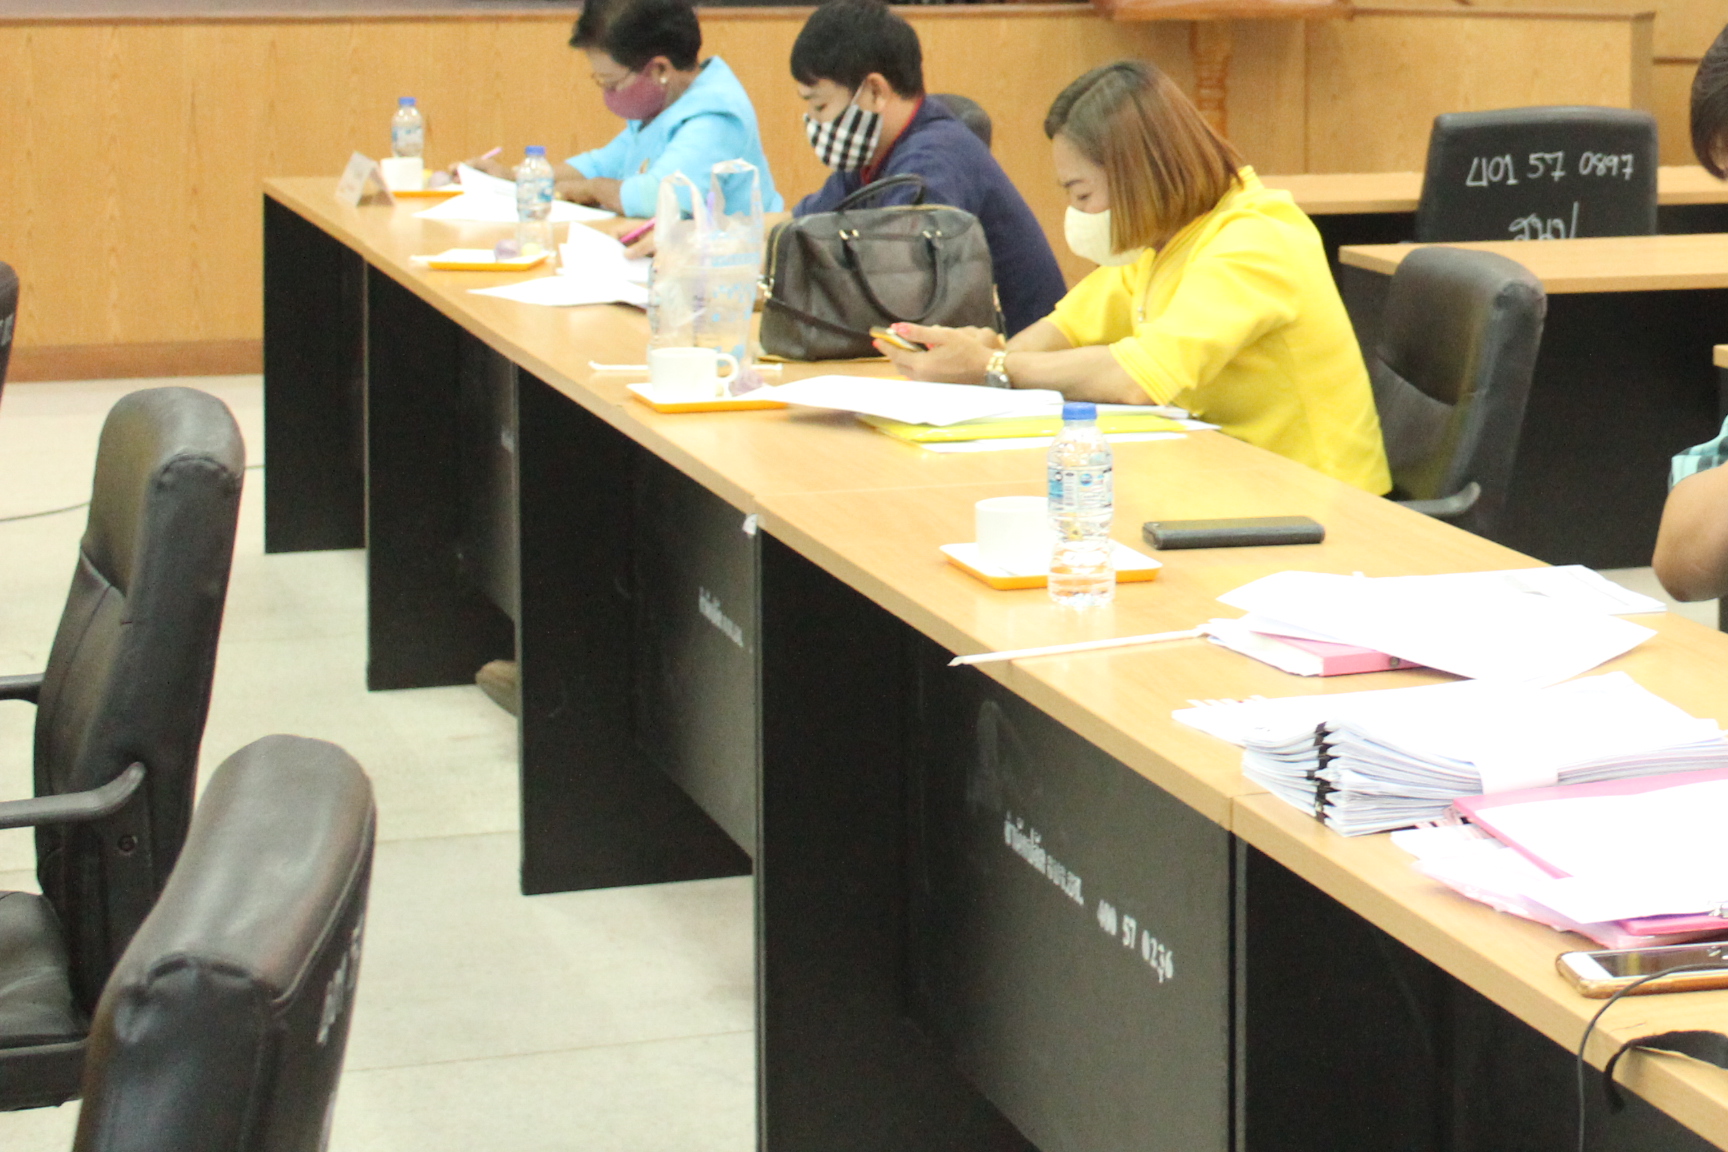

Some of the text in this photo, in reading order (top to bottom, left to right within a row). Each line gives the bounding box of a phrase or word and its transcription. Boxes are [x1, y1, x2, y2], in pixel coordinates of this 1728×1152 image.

[1465, 151, 1634, 187] 401 57 0897
[1123, 914, 1137, 949] 57
